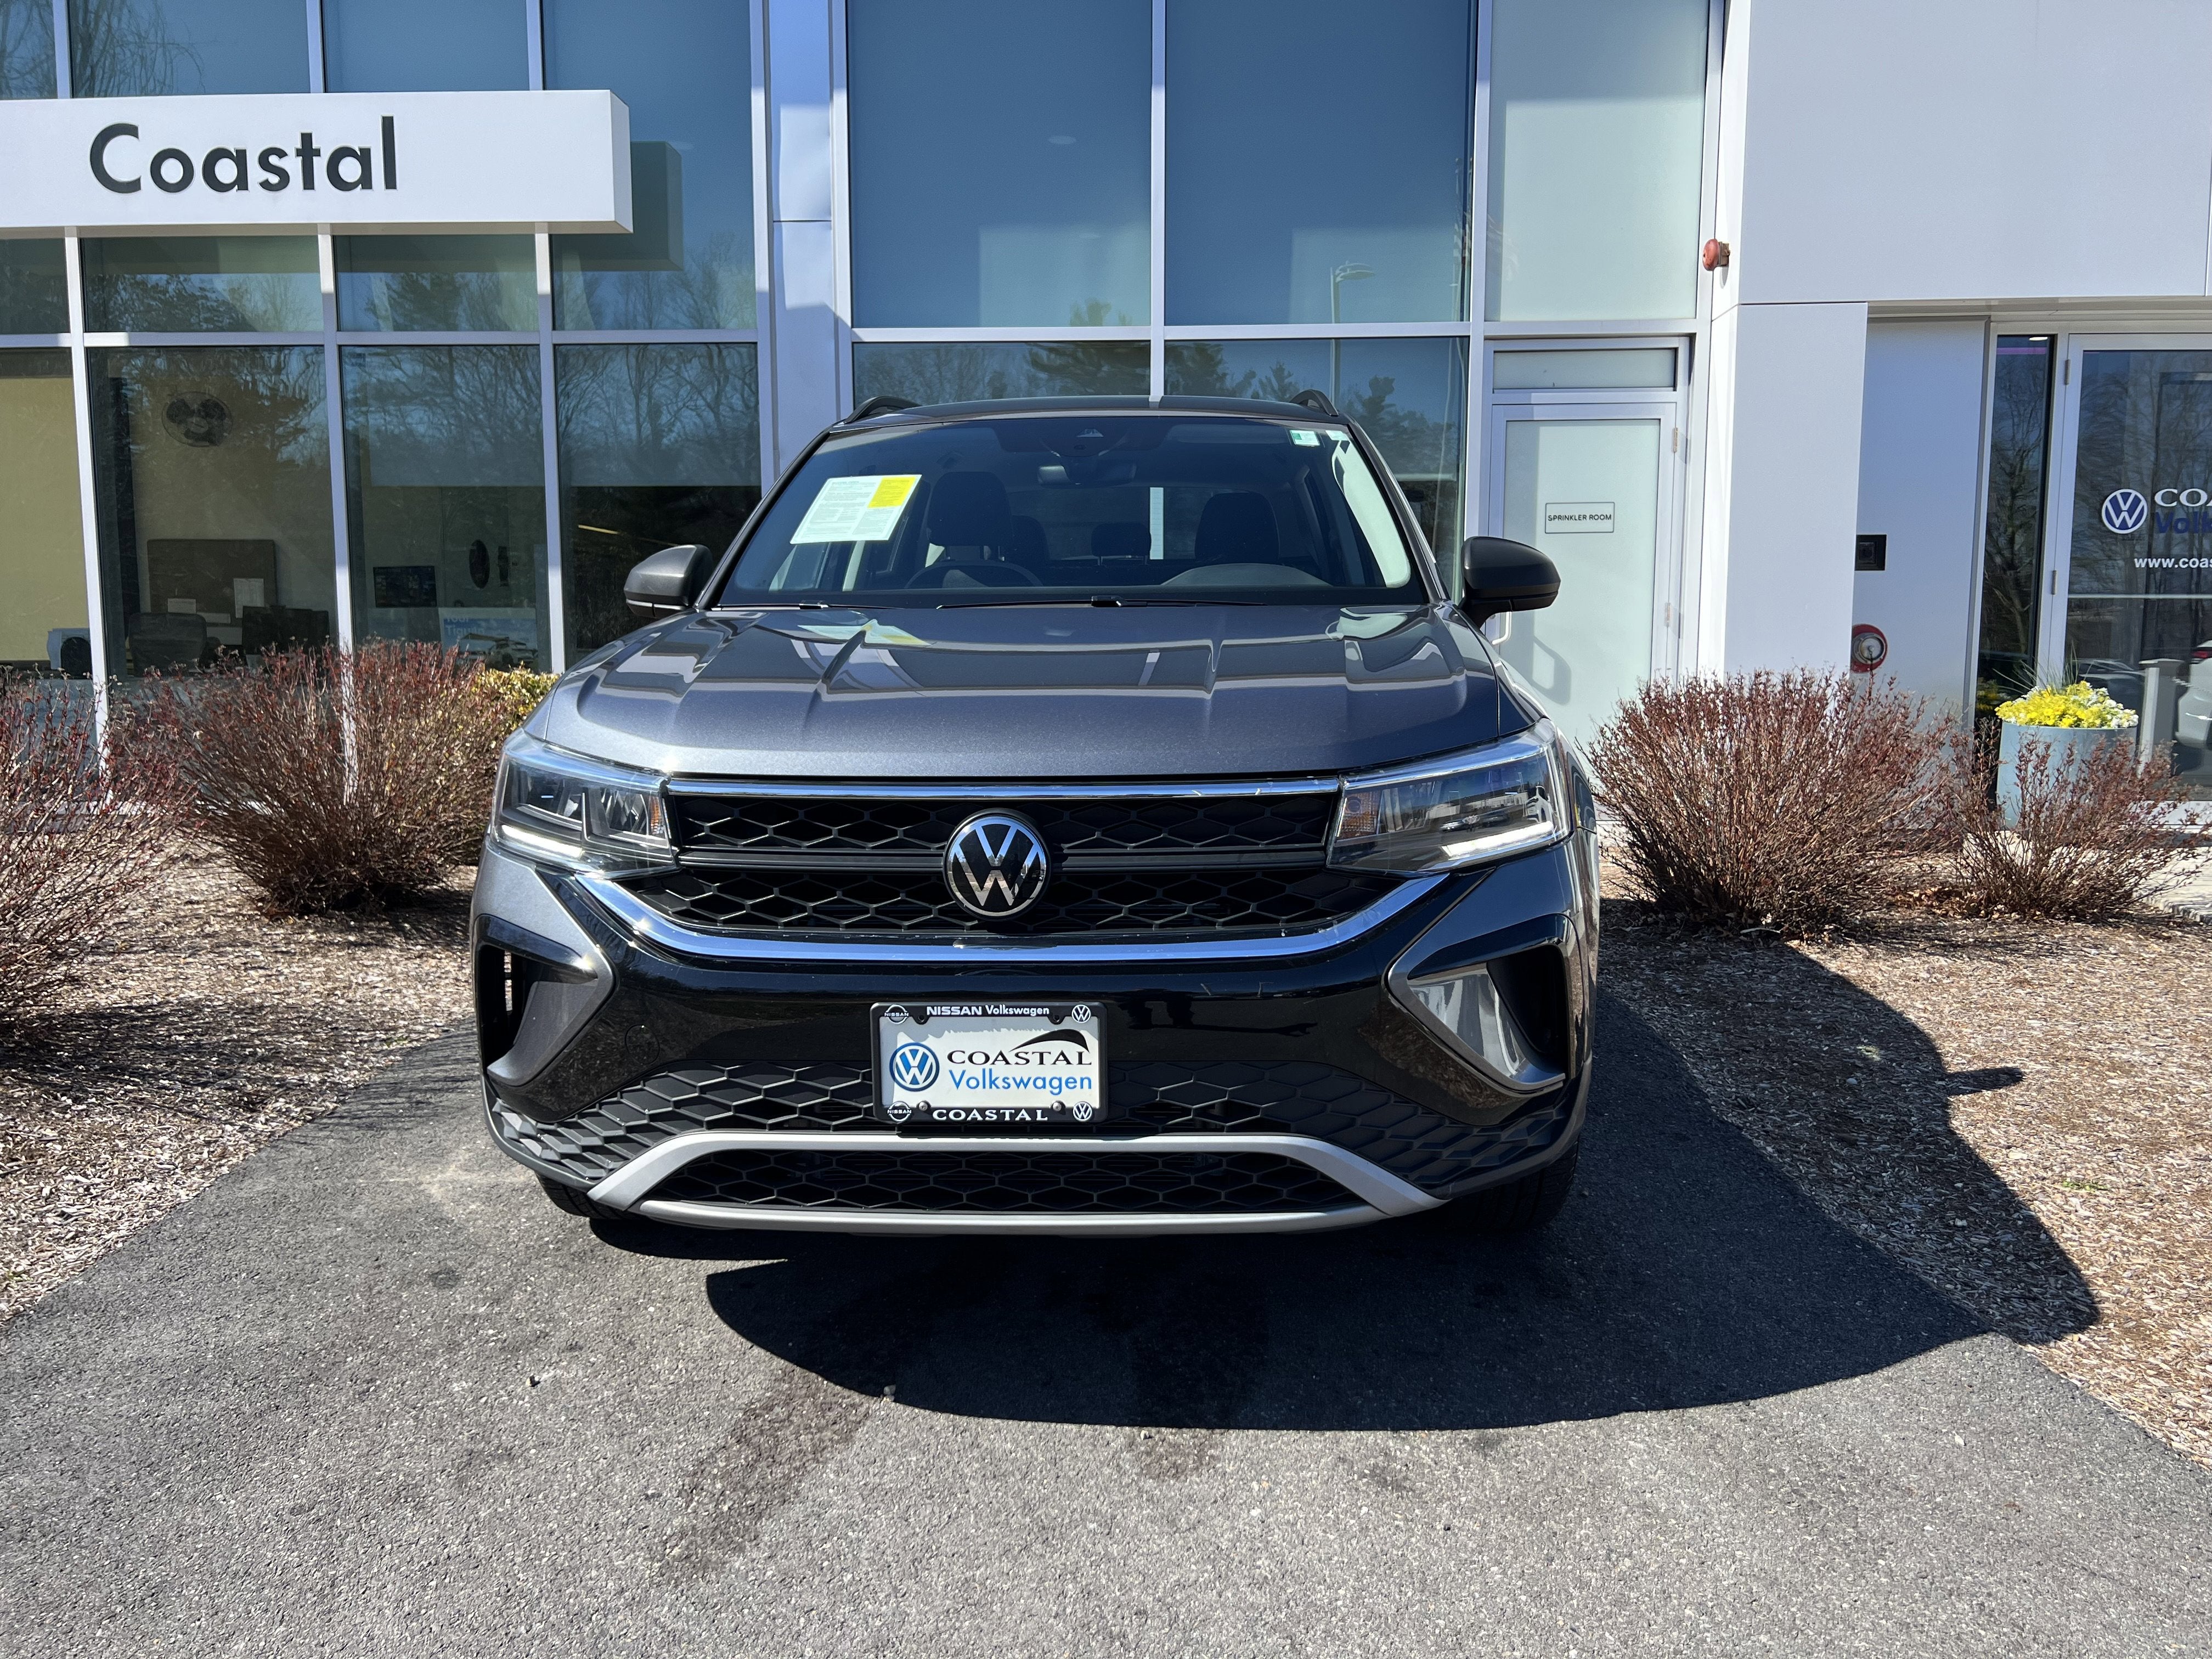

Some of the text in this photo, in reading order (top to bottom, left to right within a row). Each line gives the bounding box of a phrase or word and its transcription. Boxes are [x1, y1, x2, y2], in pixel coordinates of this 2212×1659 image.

[89, 114, 397, 194] Coastal
[2154, 488, 2212, 507] CO
[2102, 488, 2148, 534] VW
[946, 815, 1047, 917] VW
[927, 1005, 1049, 1017] NISSAN Volkswagen
[1071, 1004, 1091, 1023] VW
[947, 1049, 1092, 1065] COASTAL
[889, 1042, 940, 1092] VW
[949, 1068, 1092, 1096] Volkswagen
[933, 1109, 1048, 1121] COASTAL
[1073, 1102, 1092, 1121] VW
